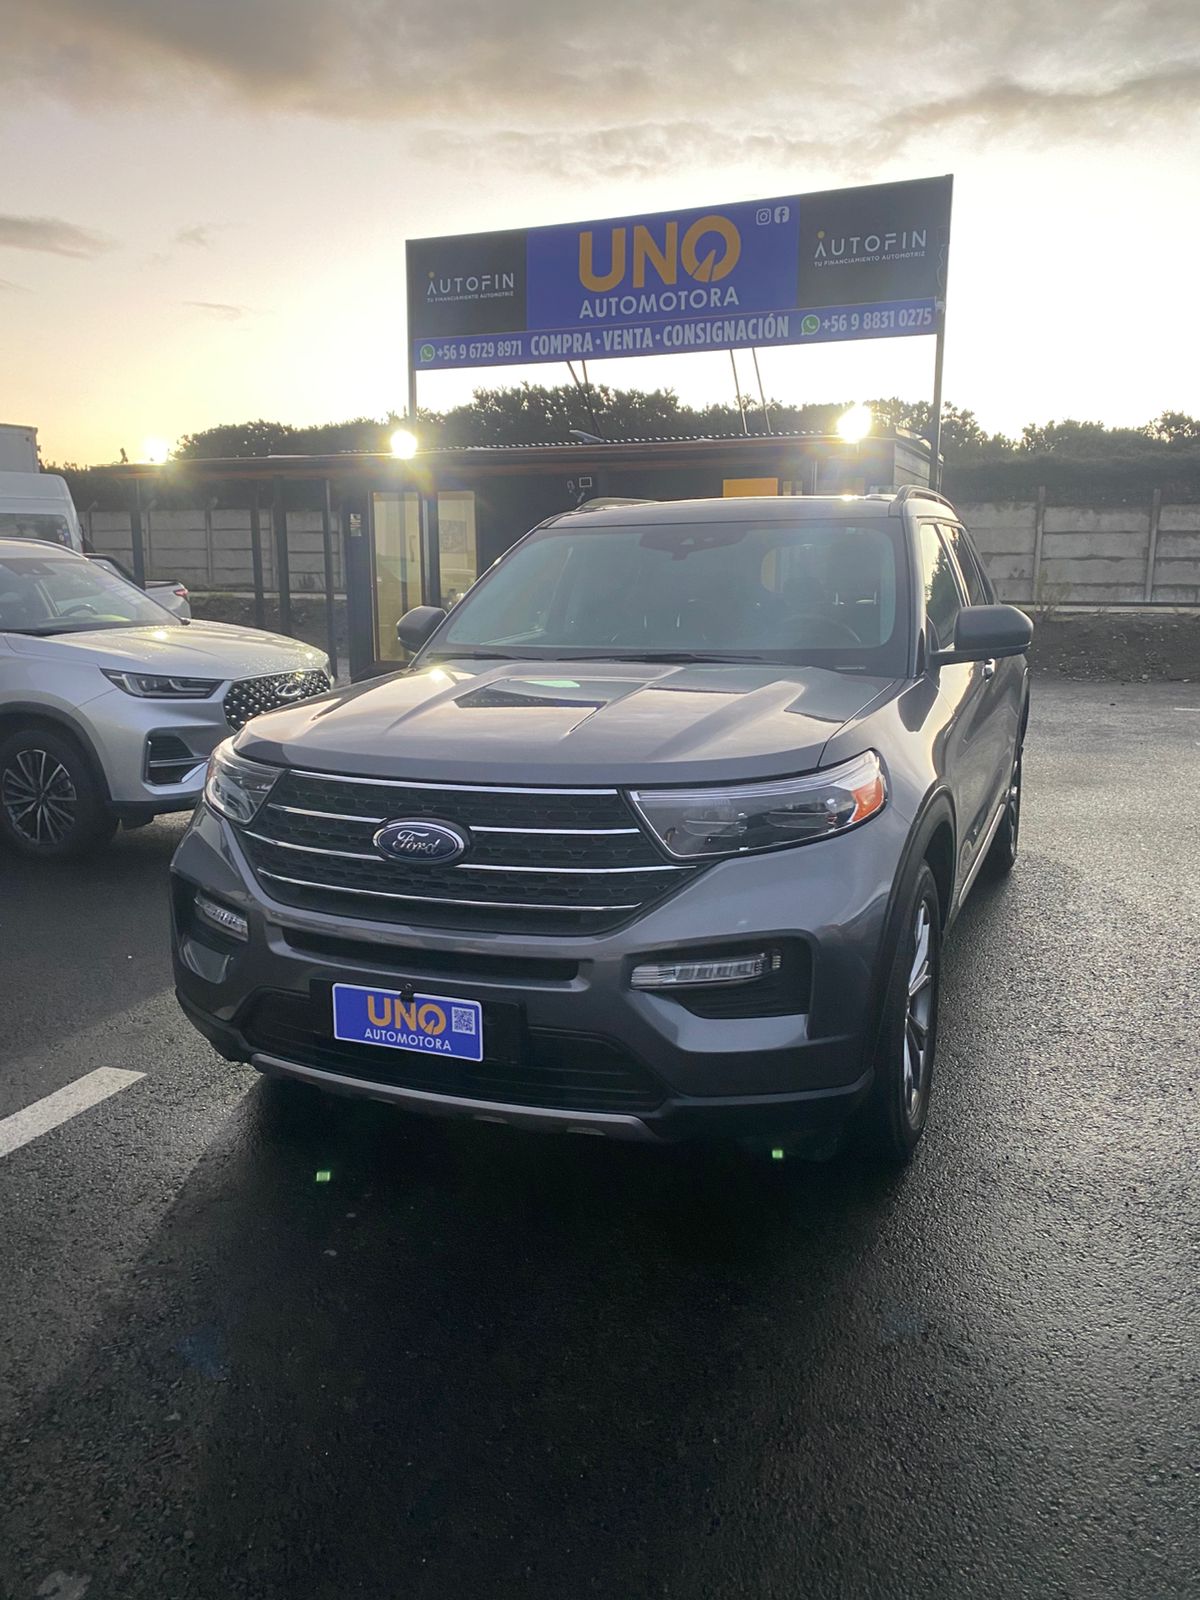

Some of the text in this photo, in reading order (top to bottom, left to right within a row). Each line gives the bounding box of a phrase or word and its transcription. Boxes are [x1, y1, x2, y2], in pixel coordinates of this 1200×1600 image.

[578, 214, 741, 293] UNO
[814, 229, 927, 258] AUTOFIN
[823, 255, 880, 266] FINANCIAMIENTO
[881, 250, 926, 261] AUTOMOTRIZ
[426, 271, 515, 296] AUTOFIN
[578, 286, 740, 319] AUTOMOTORA
[822, 307, 932, 332] +56 9 8831 0275
[437, 340, 522, 360] +56 9 6729 8971
[391, 829, 441, 855] Ford
[367, 995, 447, 1036] UNO
[363, 1027, 452, 1051] AUTOMOTORA
